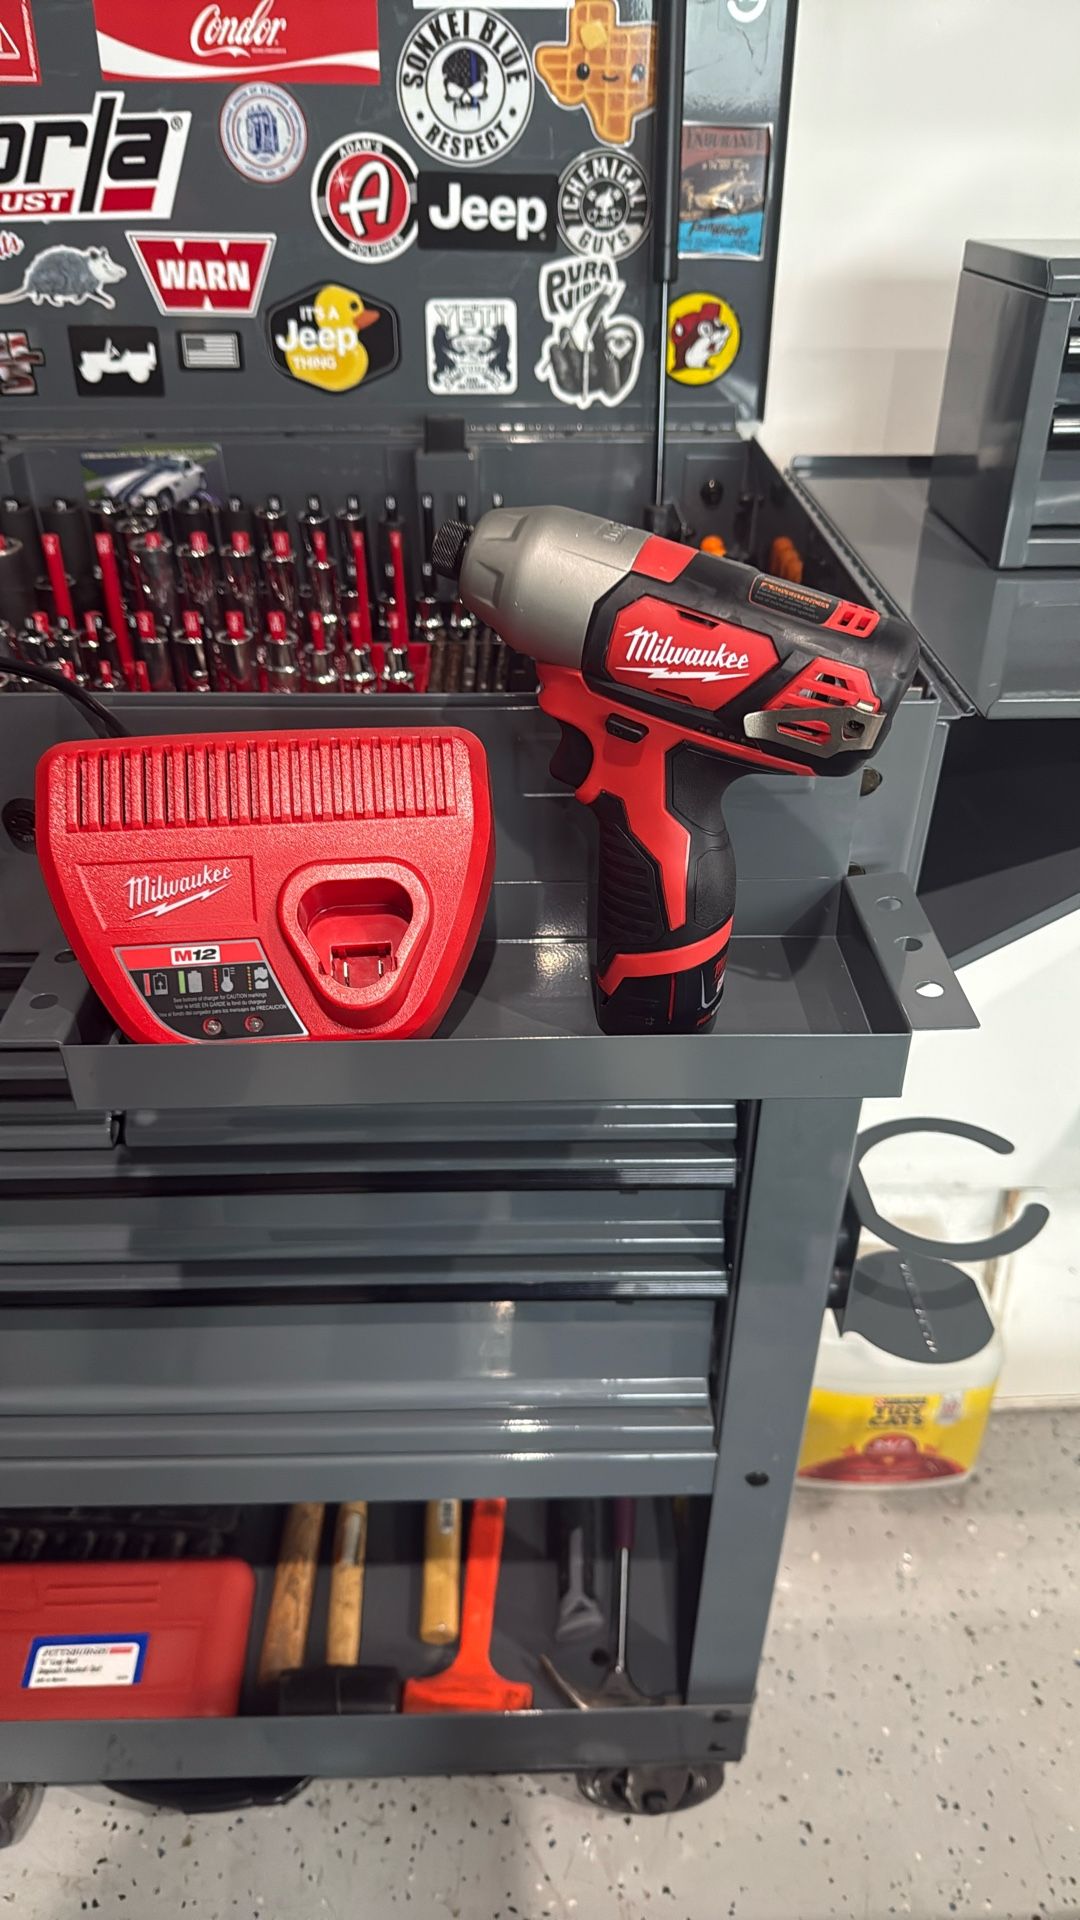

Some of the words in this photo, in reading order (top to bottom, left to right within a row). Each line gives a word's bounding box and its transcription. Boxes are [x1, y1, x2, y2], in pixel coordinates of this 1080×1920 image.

[190, 0, 287, 57] Condor
[403, 10, 470, 88] SONKEI
[479, 15, 527, 84] BLUE
[339, 140, 383, 157] ADAM'S
[425, 121, 509, 158] RESPECT
[339, 160, 389, 237] A
[562, 156, 647, 210] CHEMICAL
[428, 182, 547, 241] Jeep
[578, 230, 631, 253] GUYS
[156, 259, 251, 291] WARN
[546, 260, 612, 313] PURA
[299, 305, 325, 321] IT'S
[328, 305, 340, 320] A
[275, 318, 359, 357] Jeep
[292, 355, 338, 370] THING
[624, 626, 749, 669] Milwaukee
[122, 864, 233, 910] Milwaukee
[174, 948, 217, 962] M12
